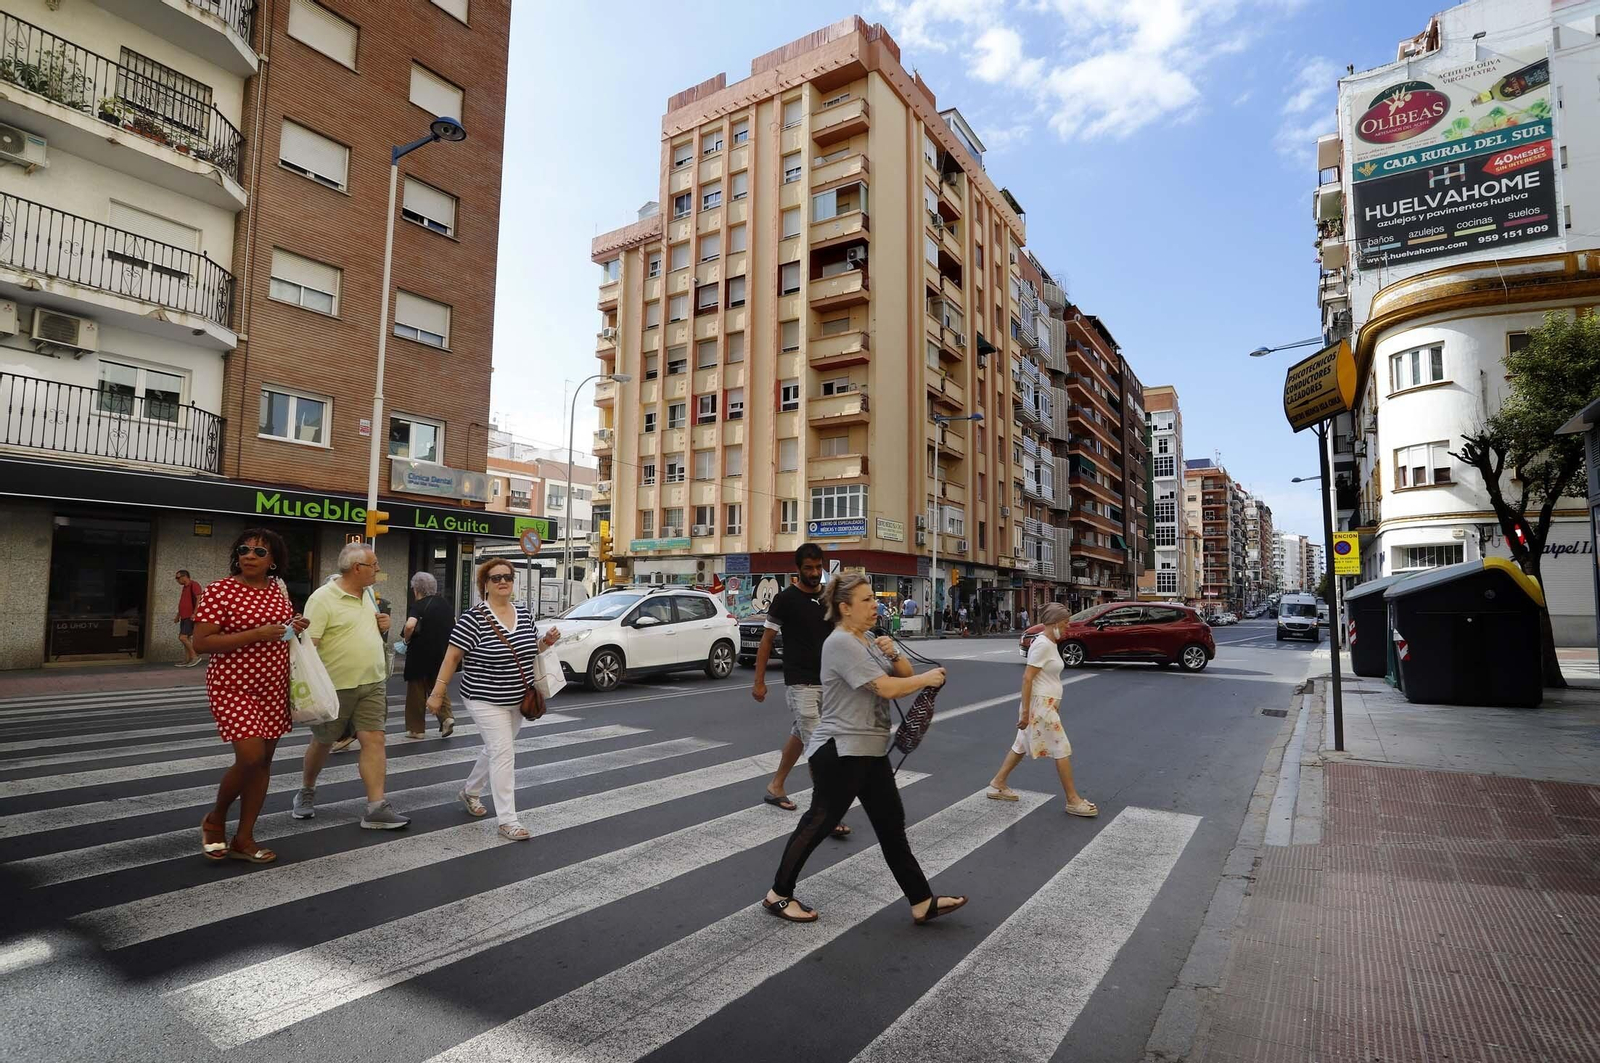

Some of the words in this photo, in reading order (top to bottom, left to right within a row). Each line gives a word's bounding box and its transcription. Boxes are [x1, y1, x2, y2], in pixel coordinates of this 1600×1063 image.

[1438, 69, 1463, 80] ACEITE
[1464, 66, 1474, 74] DE
[1476, 58, 1501, 71] OLIVA
[1442, 73, 1473, 85] VIRGEN
[1475, 66, 1497, 79] EXTRA
[1360, 101, 1444, 134] OLIBEAS
[1383, 154, 1418, 170] CAJA
[1421, 144, 1472, 162] RURAL
[1475, 134, 1507, 150] DEL
[1511, 124, 1547, 141] SUR
[1495, 164, 1508, 173] SIN
[1508, 152, 1547, 170] INTERESES
[1365, 171, 1541, 222] HUELVAHOME
[1376, 213, 1417, 228] azulejos
[1418, 213, 1426, 223] y
[1426, 200, 1489, 220] pavimentos
[1491, 191, 1528, 206] huelva
[1368, 234, 1395, 248] baños
[1408, 225, 1445, 240] azulejos
[1456, 216, 1494, 230] cocinas
[1508, 206, 1540, 220] suelos
[1366, 240, 1468, 264] www.huelvahome.com
[1478, 234, 1500, 244] 959
[1502, 230, 1523, 240] 151
[1526, 224, 1549, 236] 809
[1286, 365, 1332, 395] CONDUCTORES
[1287, 380, 1323, 405] CAZADORES
[256, 490, 367, 522] Mueble
[444, 516, 490, 534] Guita
[1542, 541, 1579, 559] arpel
